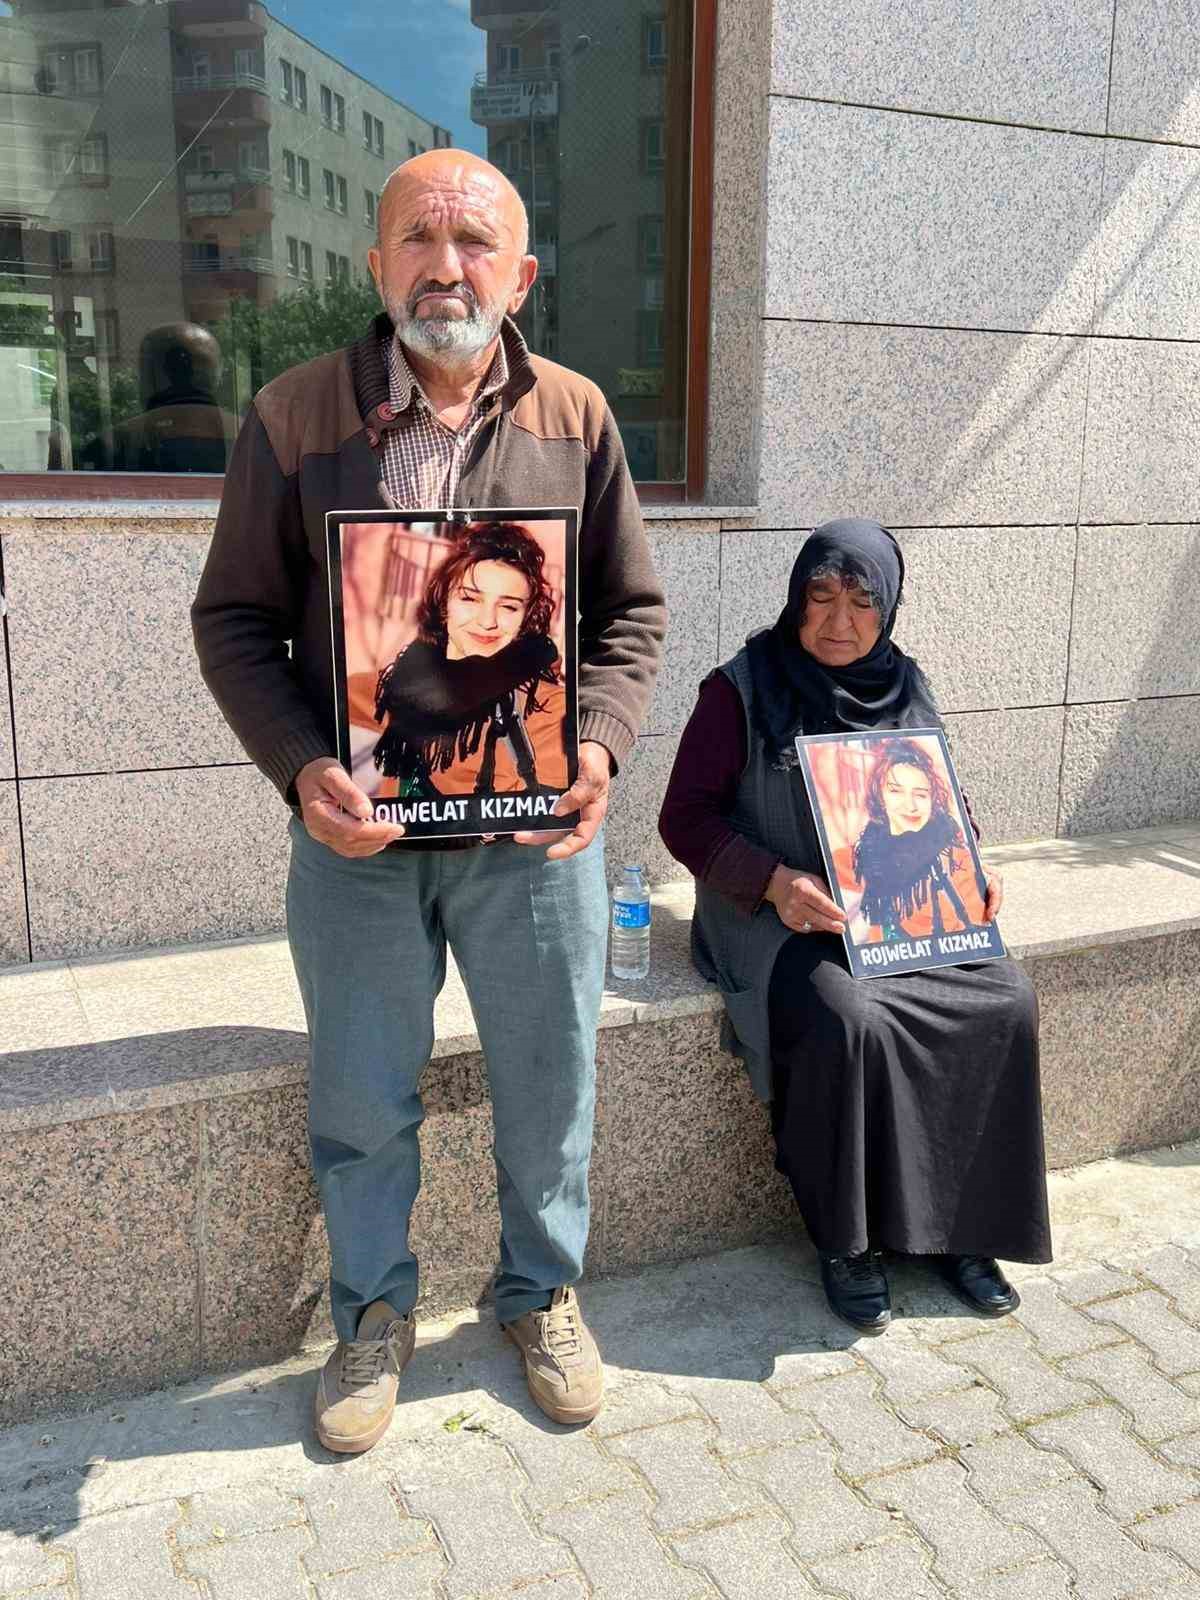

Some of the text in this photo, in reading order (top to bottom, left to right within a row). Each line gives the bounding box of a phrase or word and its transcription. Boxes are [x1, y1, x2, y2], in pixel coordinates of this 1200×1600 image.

[362, 801, 468, 824] OJWELAT
[860, 931, 992, 966] ROJWELAT KIZMAZ
